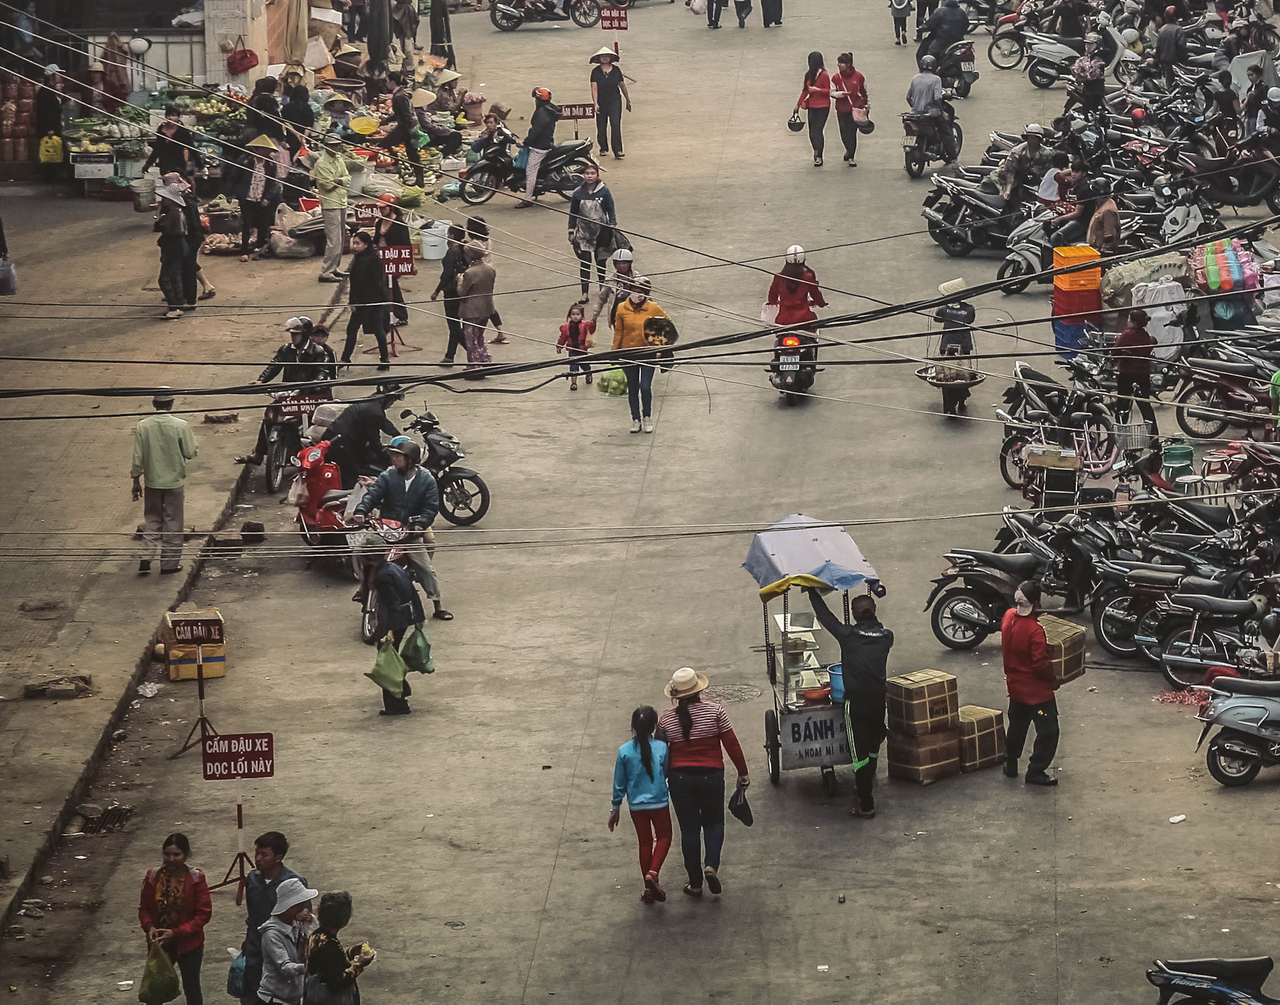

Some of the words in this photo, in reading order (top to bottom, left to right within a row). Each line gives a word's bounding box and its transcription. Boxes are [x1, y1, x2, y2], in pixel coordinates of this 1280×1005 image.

[562, 106, 571, 116] ẤM
[586, 107, 593, 116] XE
[385, 248, 398, 259] ĐẬU
[401, 250, 410, 258] XE
[385, 262, 395, 272] LỐI
[399, 262, 412, 272] NÀY
[282, 397, 298, 412] CẤM
[300, 397, 315, 413] ĐẬU
[176, 622, 191, 640] CẤM
[211, 626, 220, 639] XE
[792, 716, 834, 743] BÁNH
[206, 736, 228, 753] CẤM
[231, 737, 252, 754] ĐẬU
[255, 738, 268, 751] XE
[825, 744, 834, 756] MÌ
[207, 762, 228, 778] DỌC
[231, 757, 248, 774] LỐI
[252, 757, 272, 773] NÀY
